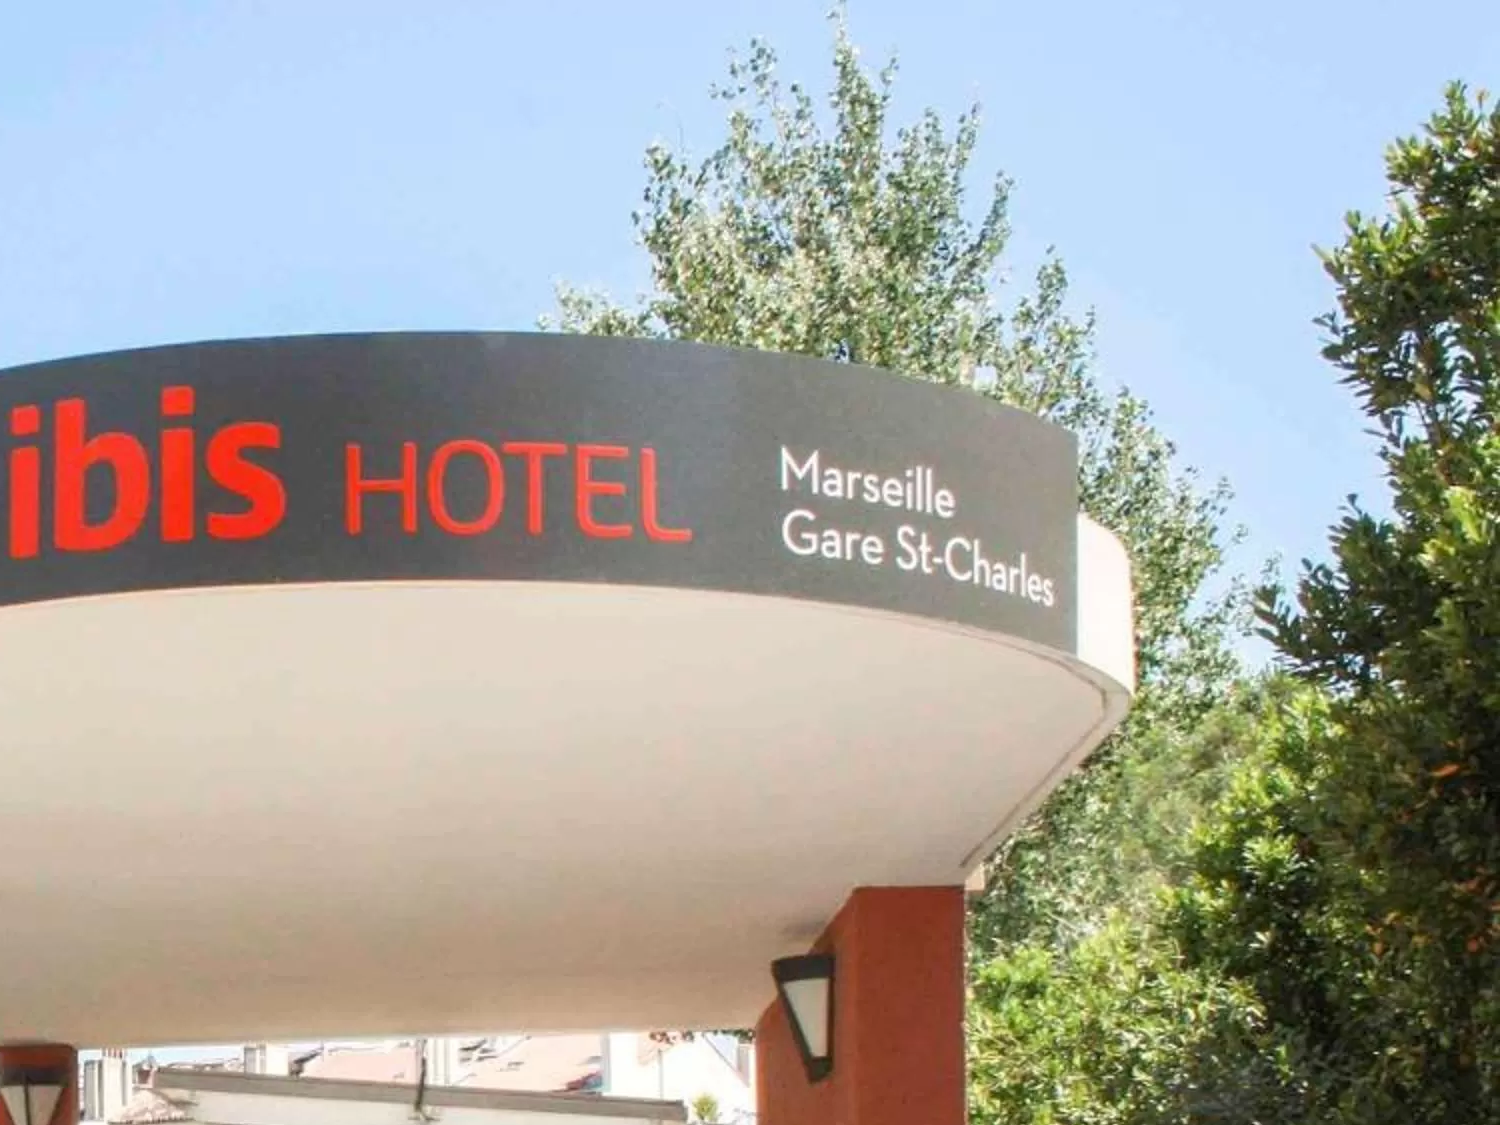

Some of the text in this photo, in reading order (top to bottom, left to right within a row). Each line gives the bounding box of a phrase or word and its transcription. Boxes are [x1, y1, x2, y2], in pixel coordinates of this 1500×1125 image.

[9, 385, 692, 558] ibis HOTEL
[780, 445, 955, 518] Marseille
[782, 509, 1053, 607] Gare St-Charles
